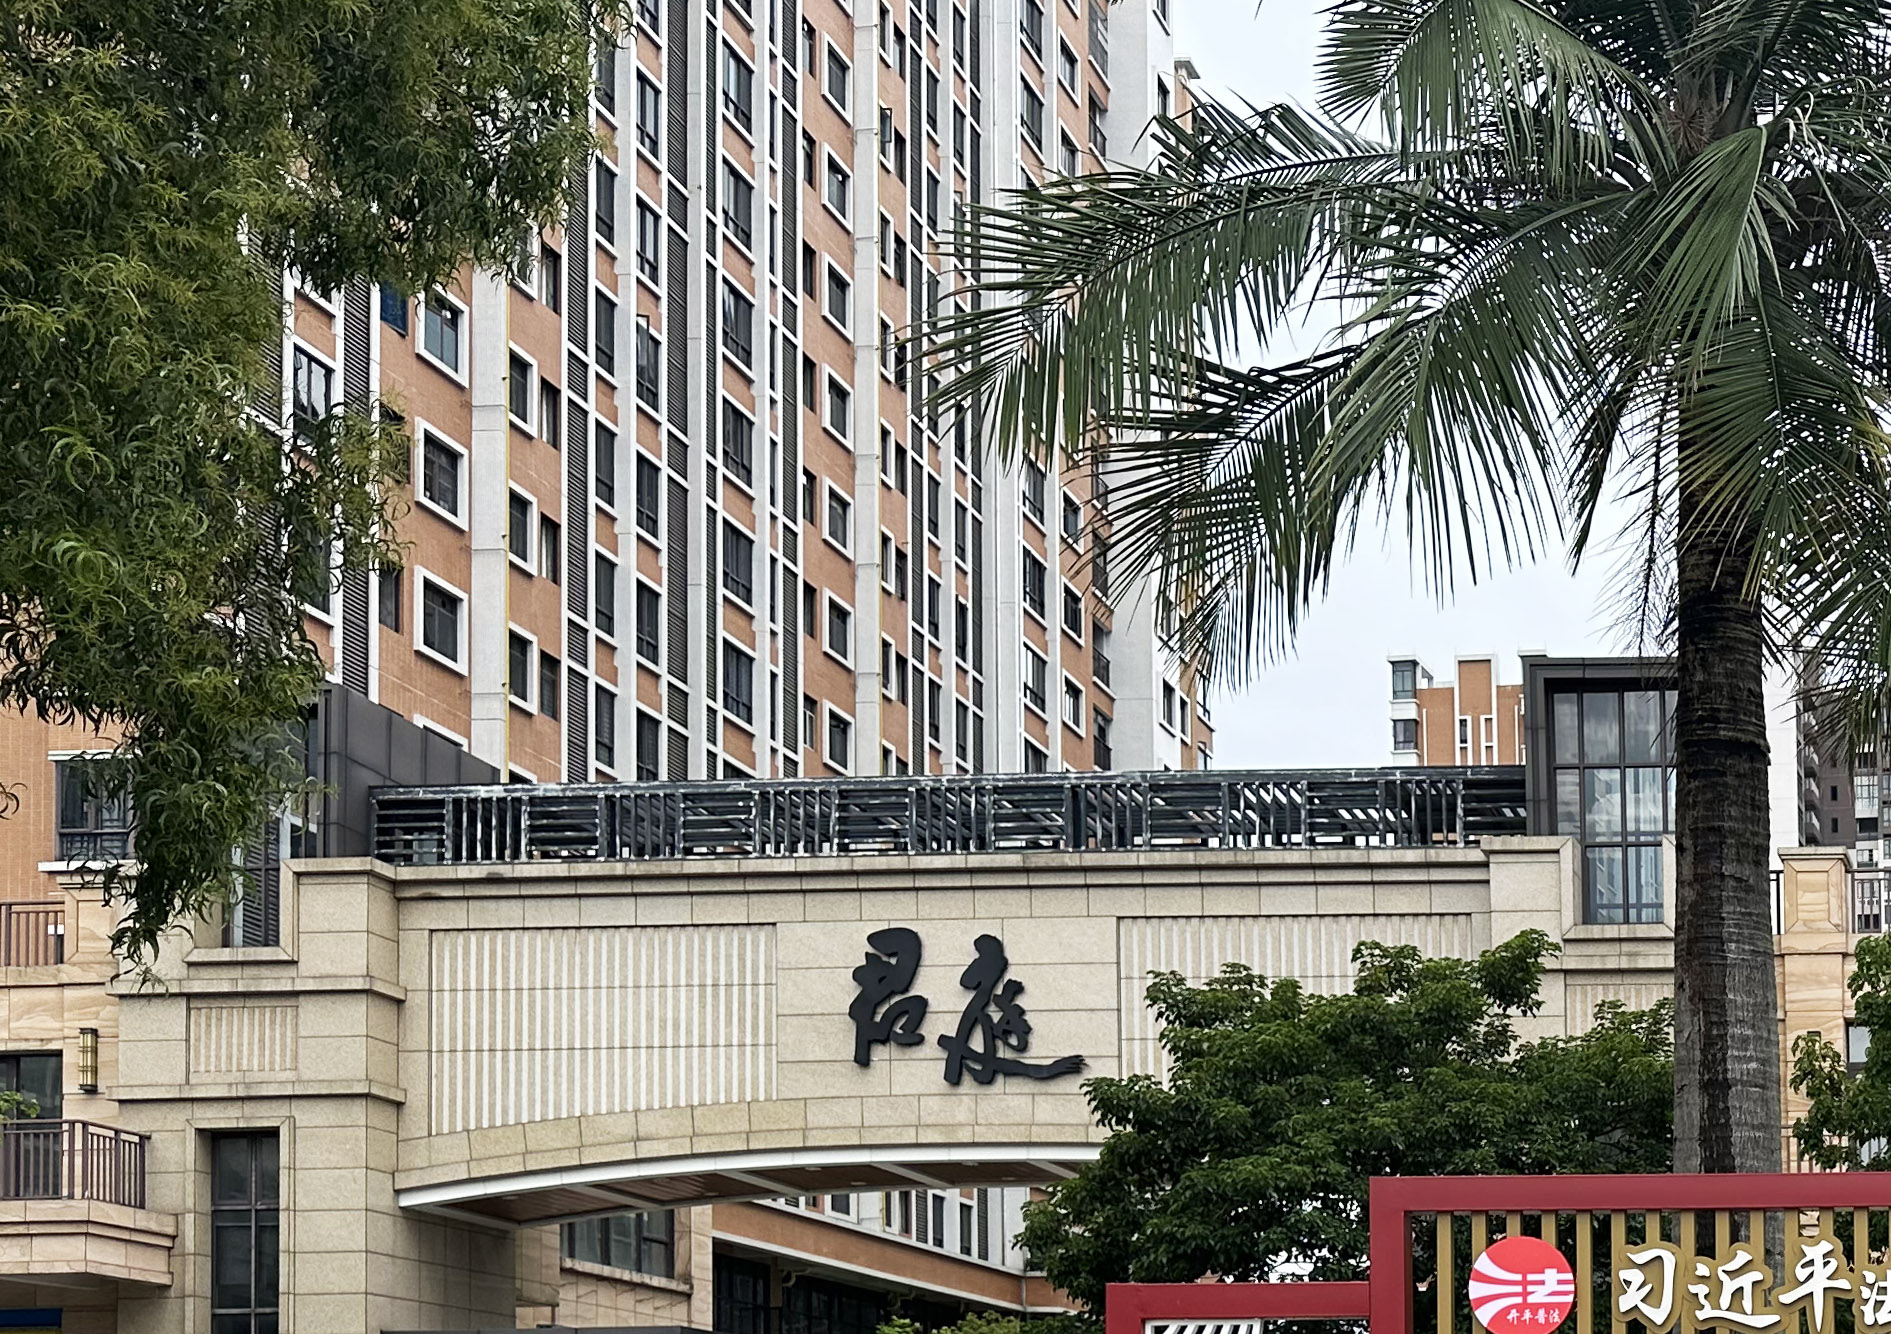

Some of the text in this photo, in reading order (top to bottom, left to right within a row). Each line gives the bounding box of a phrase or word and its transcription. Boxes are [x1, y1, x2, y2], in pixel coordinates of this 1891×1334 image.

[849, 927, 1086, 1085] 君庭
[1507, 1308, 1561, 1325] 开平普法
